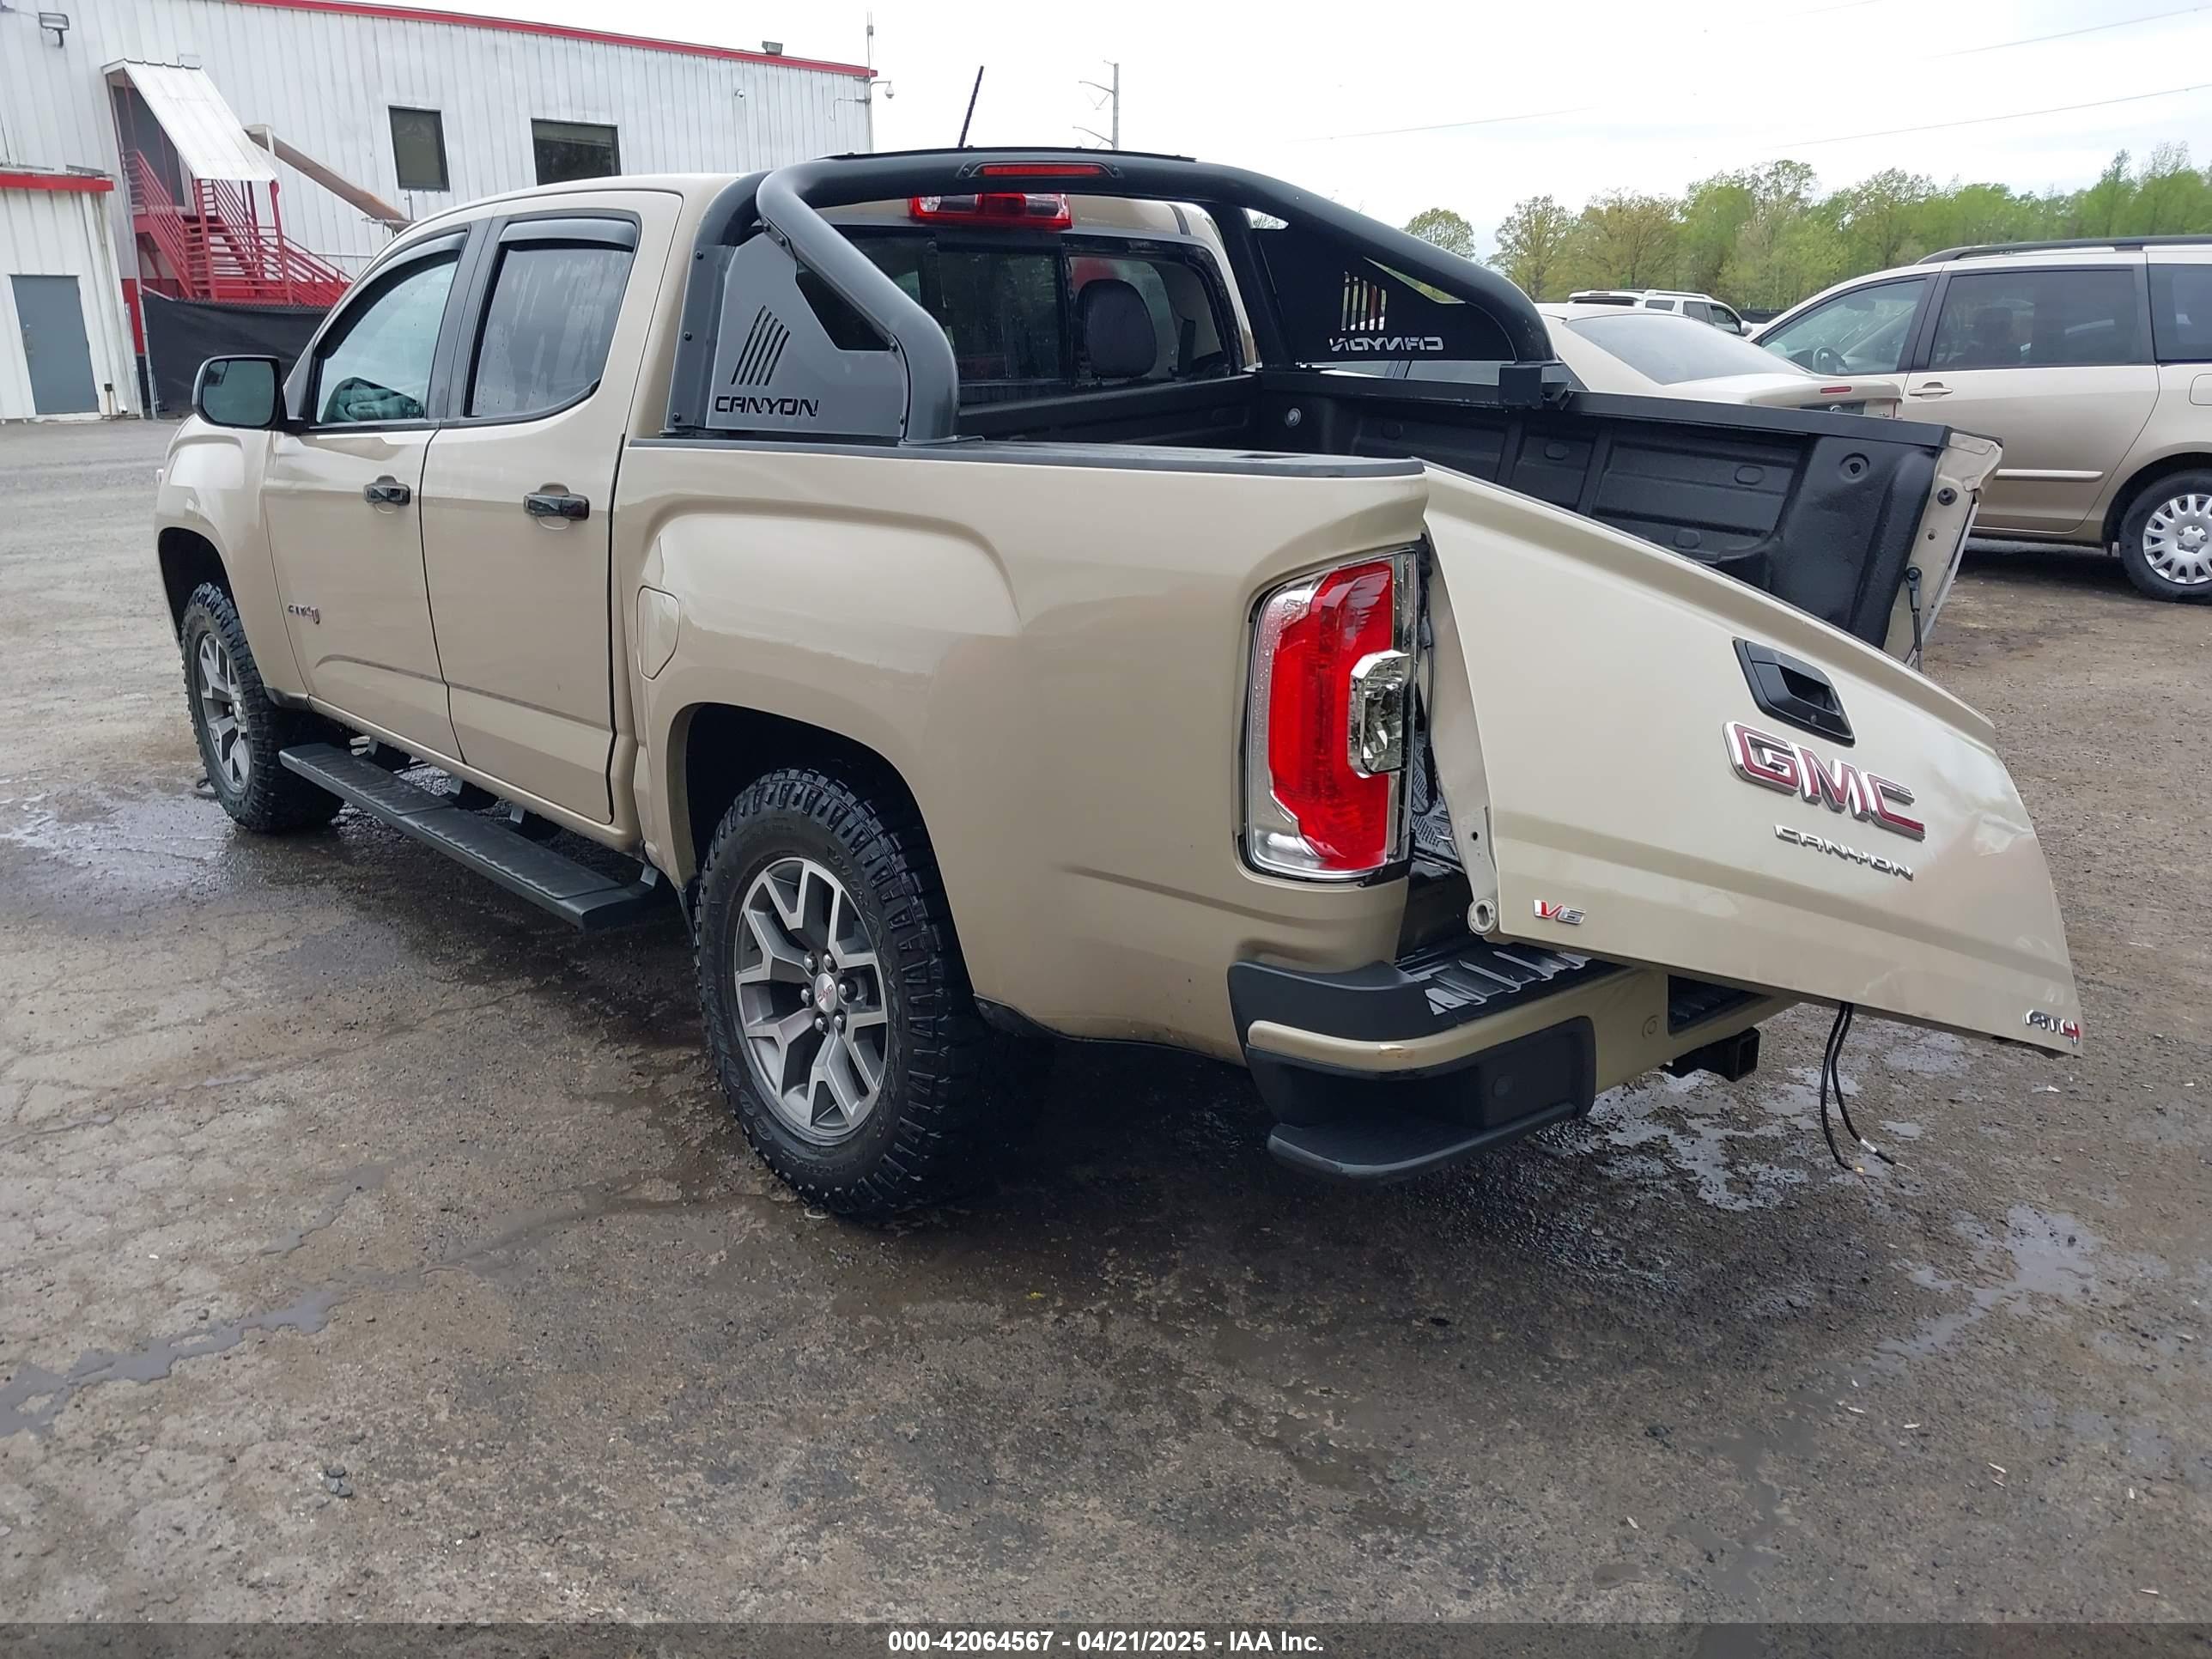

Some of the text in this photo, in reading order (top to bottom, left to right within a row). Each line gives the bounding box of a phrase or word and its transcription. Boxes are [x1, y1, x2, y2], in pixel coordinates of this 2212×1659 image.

[714, 396, 819, 416] CANYON
[1723, 721, 1926, 842] GMC
[1773, 823, 1914, 881] CANYON
[1533, 899, 1586, 925] V6
